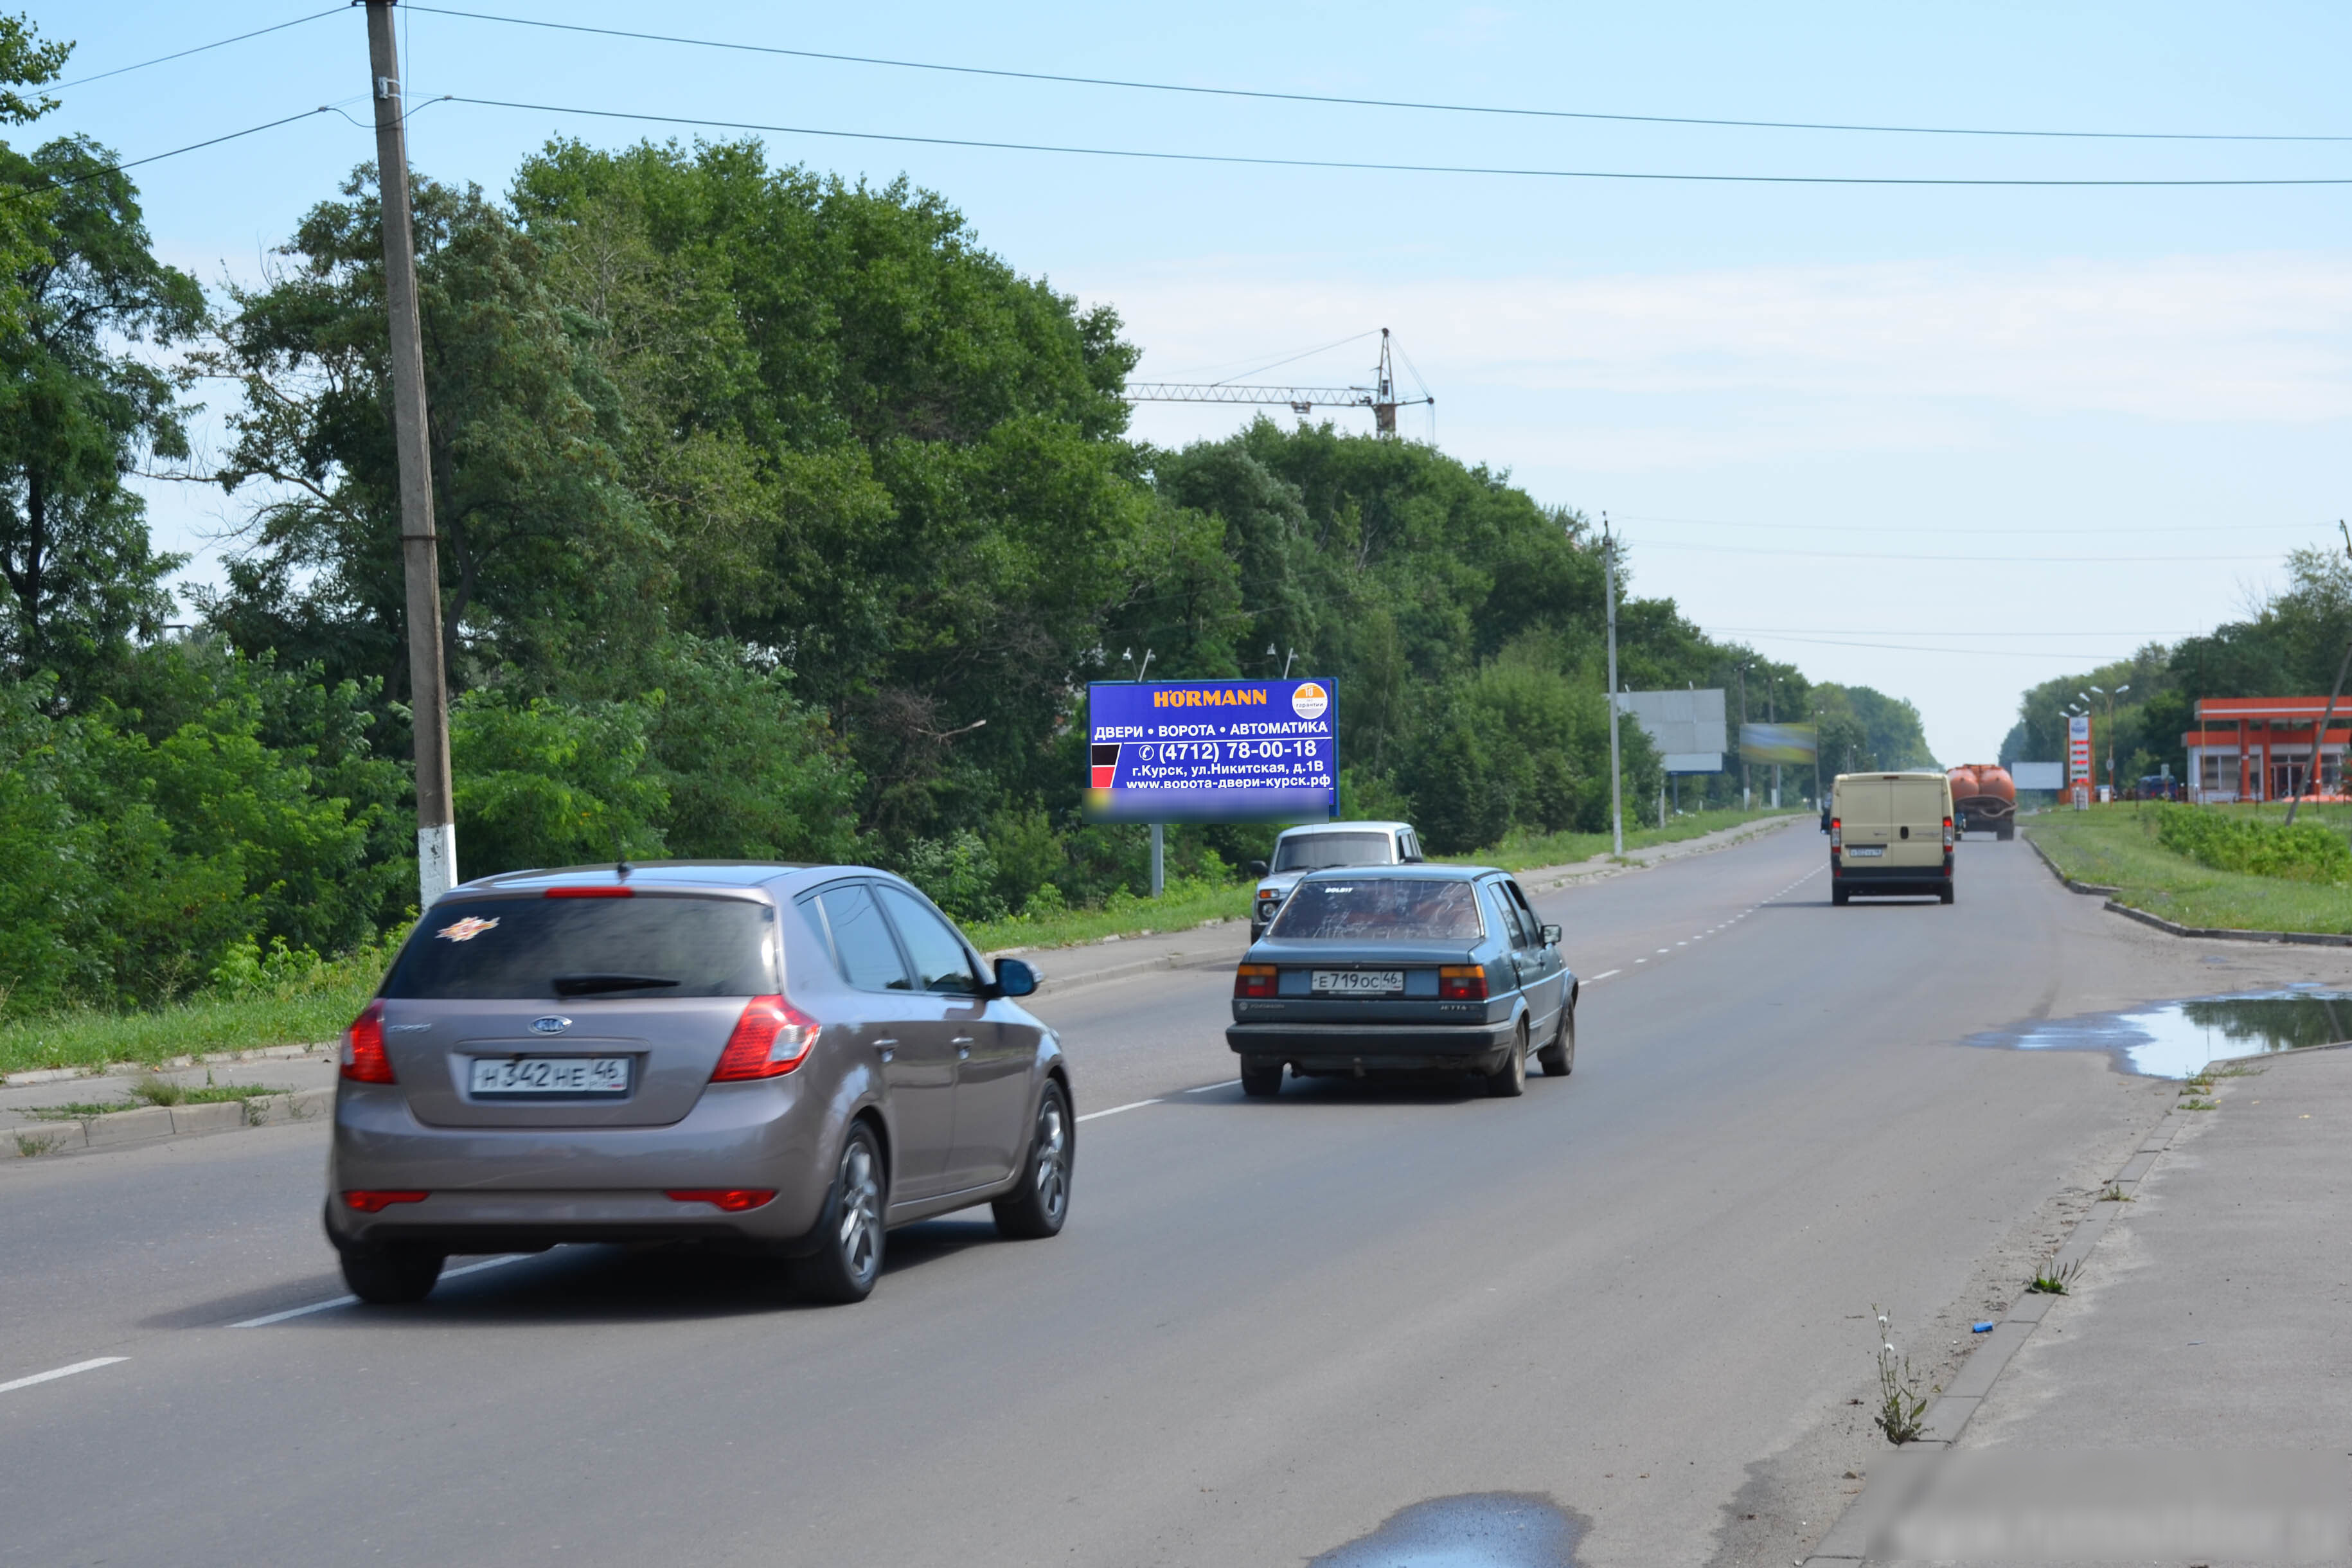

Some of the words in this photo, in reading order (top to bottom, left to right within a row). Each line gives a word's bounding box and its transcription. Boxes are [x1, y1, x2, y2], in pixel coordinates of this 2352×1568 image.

[1154, 689, 1267, 708] HÖRMANN
[1094, 726, 1143, 740] ДВЕРИ
[1159, 724, 1216, 737] ВОРОТА
[1230, 721, 1328, 736] АВТОМАТИКА
[1159, 742, 1220, 764] (4712)
[1226, 740, 1317, 759] 78-00-18
[1132, 764, 1188, 778] г.Курск,
[1191, 763, 1289, 777] ул.Никитская,
[1127, 774, 1330, 788] www.ворота-двери-курск.рф
